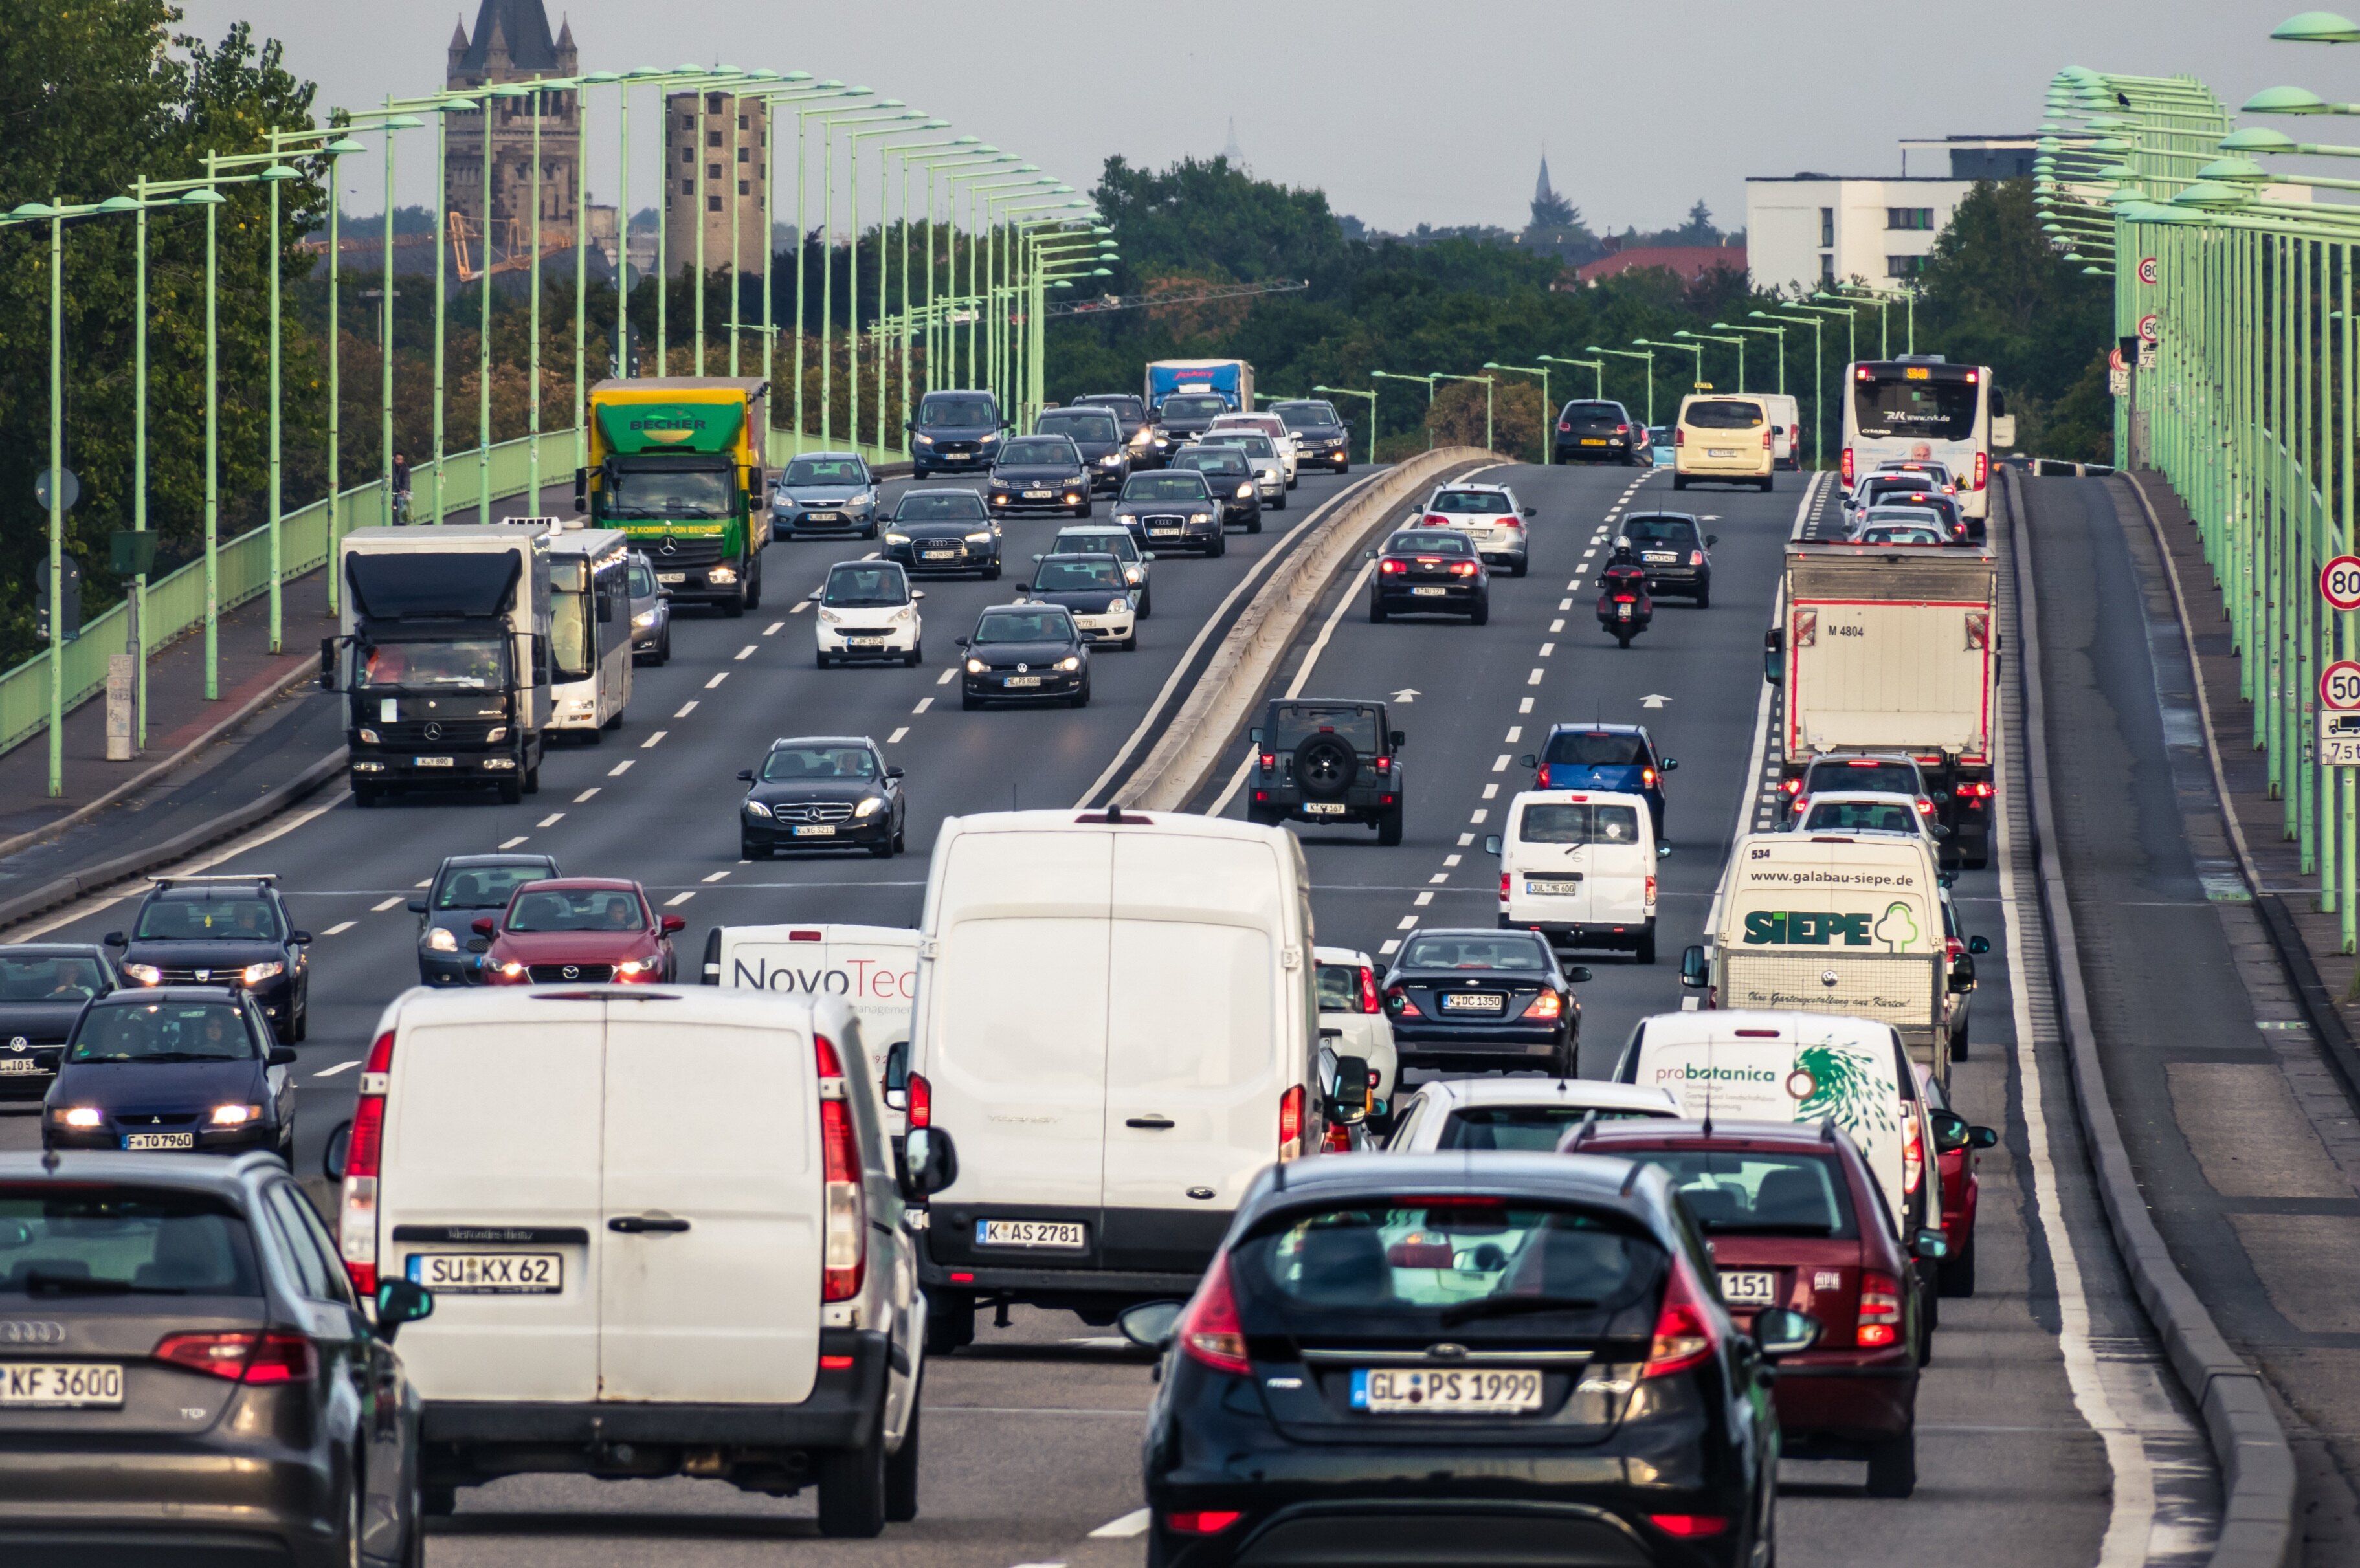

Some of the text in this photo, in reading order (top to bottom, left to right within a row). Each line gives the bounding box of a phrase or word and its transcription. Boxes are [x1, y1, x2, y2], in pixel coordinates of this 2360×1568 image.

[629, 419, 706, 430] BECHER
[2332, 570, 2360, 595] 80
[1828, 625, 1864, 637] M 4804
[2332, 676, 2360, 700] 50
[1751, 848, 1770, 859] 534
[1750, 870, 1913, 887] www.galabau-siepe.de
[1561, 885, 1575, 893] 600
[1462, 996, 1475, 1006] DC
[1476, 997, 1500, 1006] 1350
[1656, 1063, 1776, 1084] probotanica
[161, 1134, 192, 1147] 7960
[988, 1223, 1080, 1242] K AS 2781
[432, 1259, 549, 1282] SU KX 62
[1729, 1275, 1770, 1297] 151
[11, 1367, 118, 1397] KF 3600
[1371, 1373, 1537, 1401] GL PS 1999
